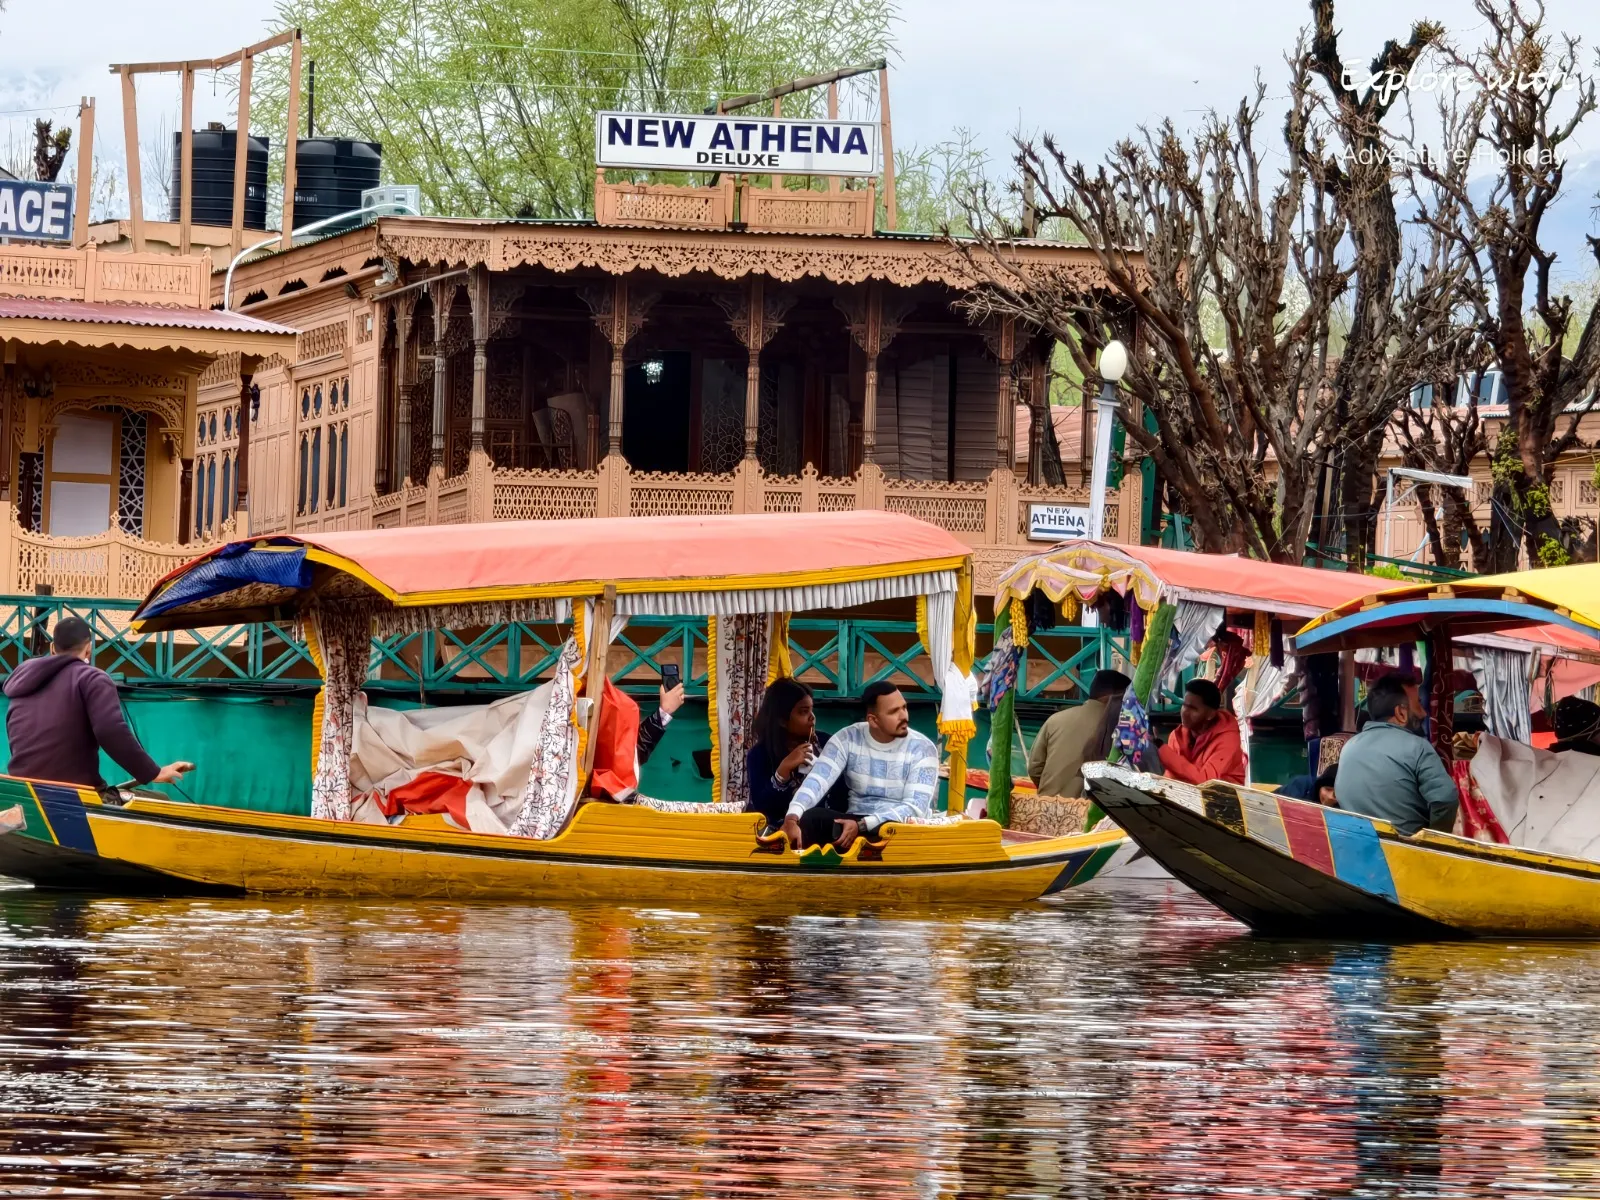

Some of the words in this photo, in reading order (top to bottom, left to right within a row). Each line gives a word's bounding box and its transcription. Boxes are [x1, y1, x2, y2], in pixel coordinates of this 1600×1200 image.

[608, 118, 696, 148] NEW
[708, 123, 869, 155] ATHENA
[697, 152, 779, 166] DELUXE
[1032, 514, 1085, 527] ATHENA
